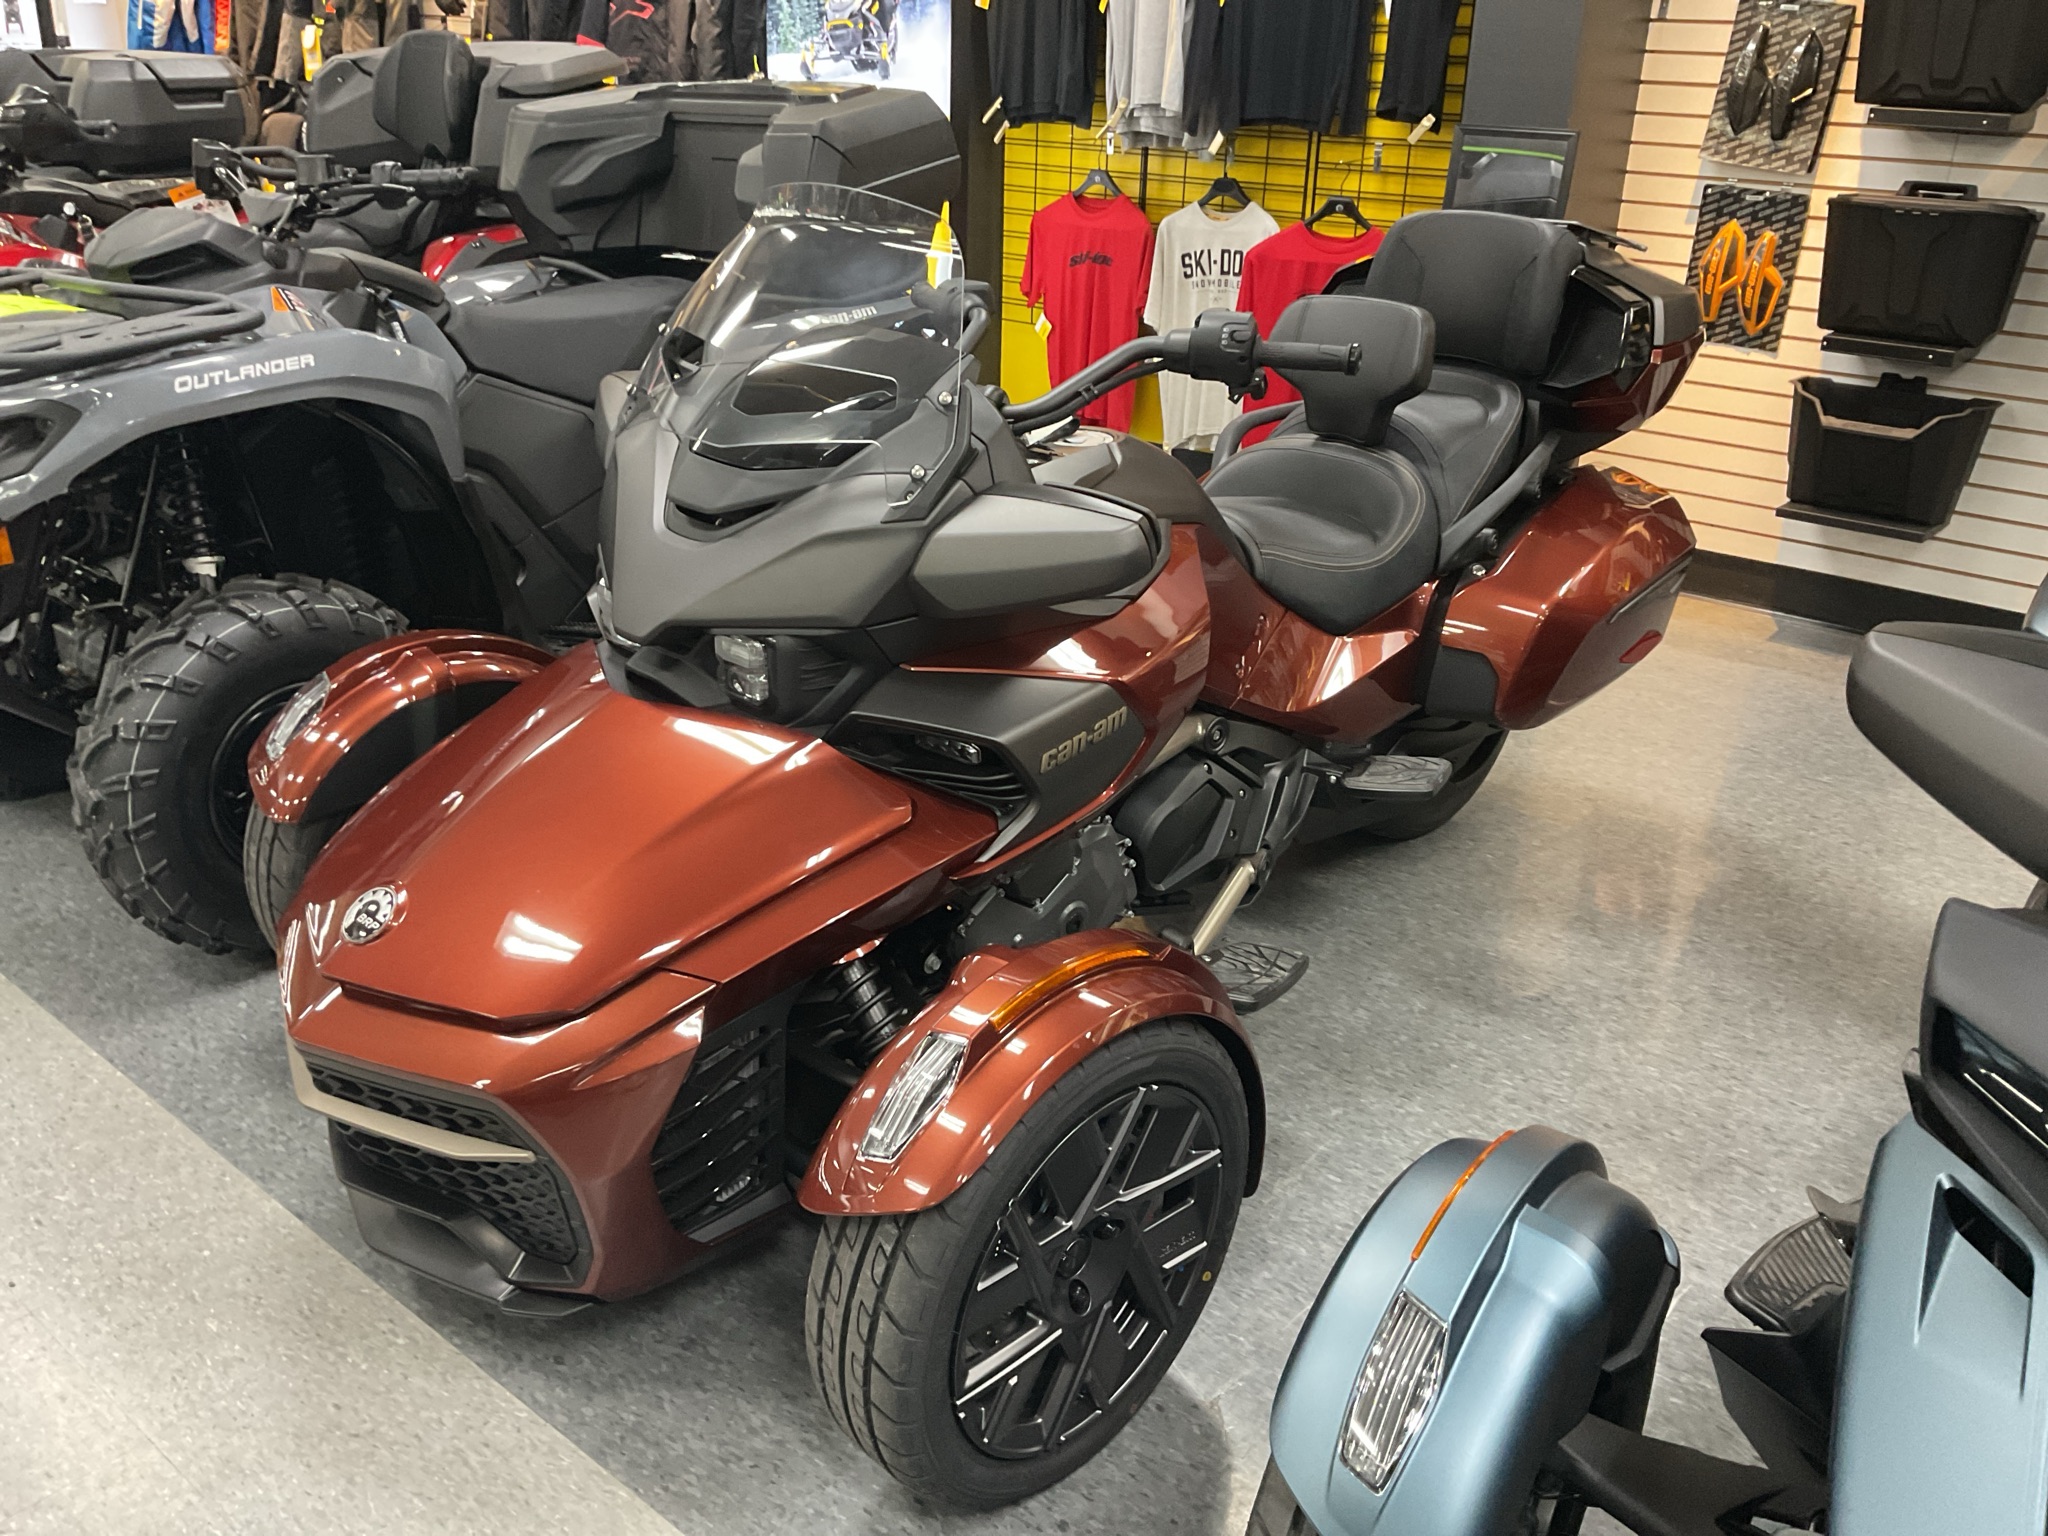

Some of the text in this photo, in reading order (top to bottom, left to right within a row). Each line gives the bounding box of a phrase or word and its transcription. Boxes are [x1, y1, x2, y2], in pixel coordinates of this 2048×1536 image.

[1181, 249, 1243, 279] SKI-DO
[174, 354, 315, 393] OUTLANDER
[1040, 706, 1127, 773] can-am
[357, 913, 380, 929] BRP
